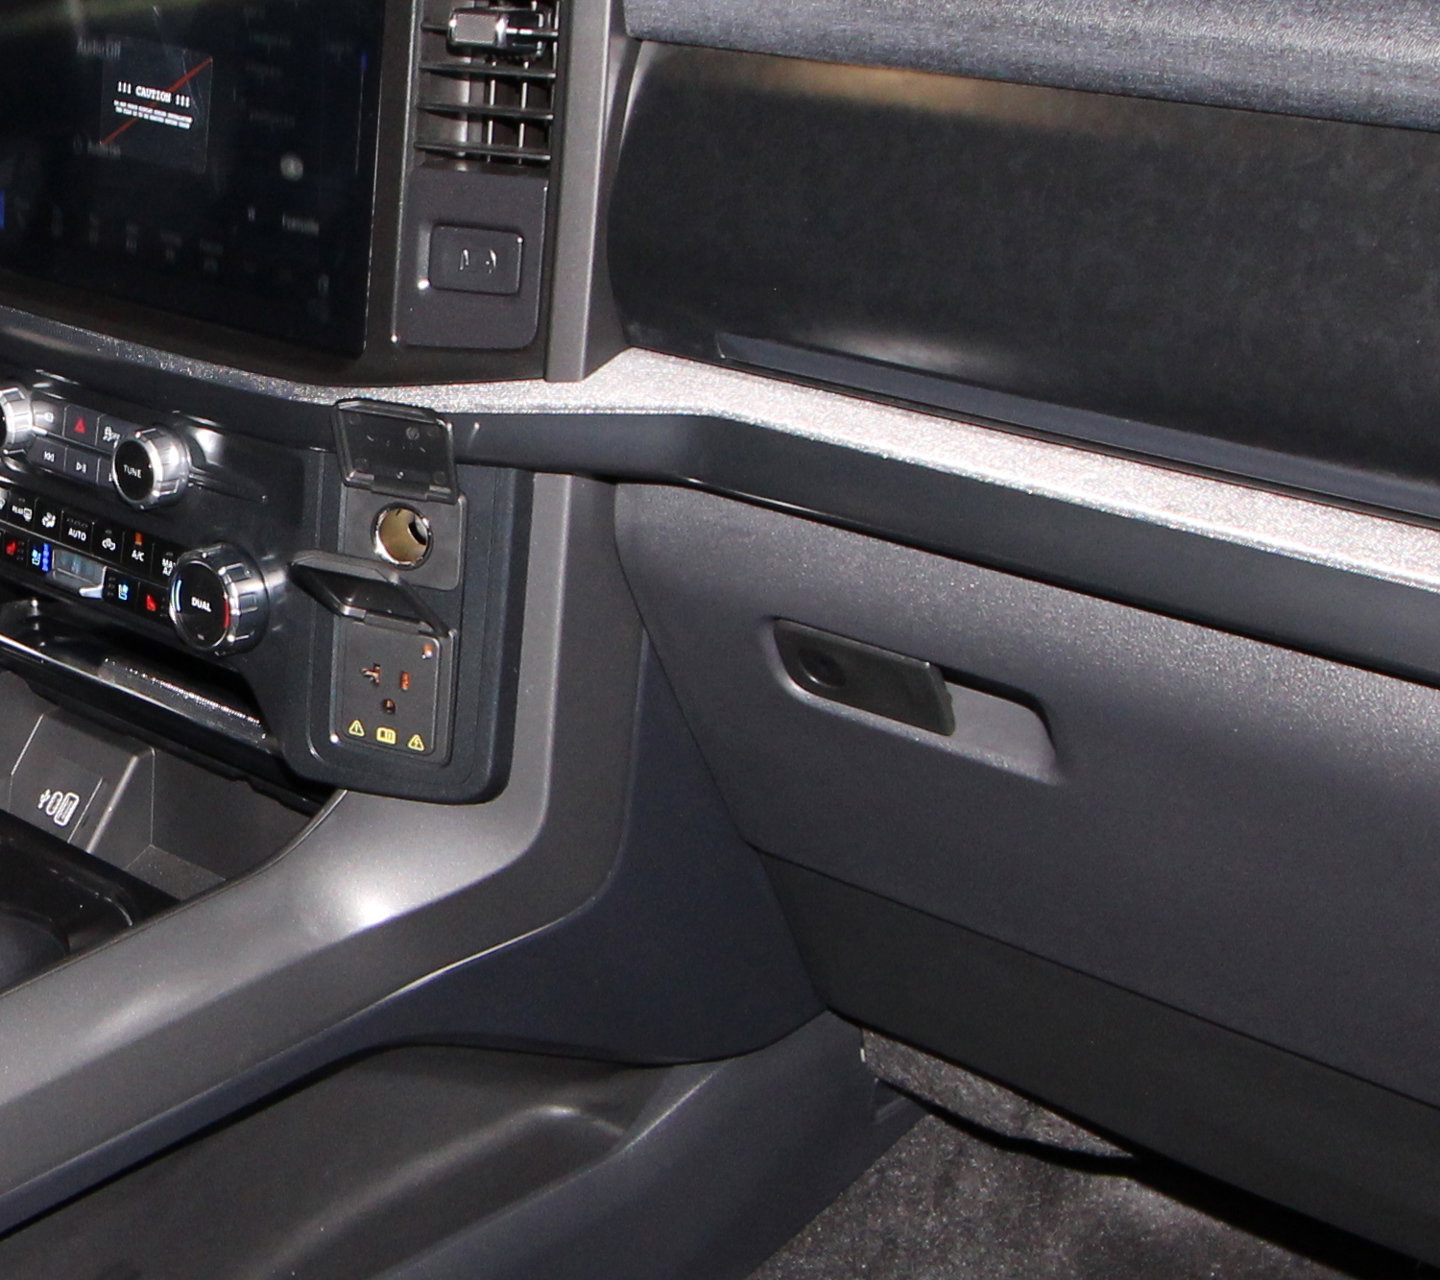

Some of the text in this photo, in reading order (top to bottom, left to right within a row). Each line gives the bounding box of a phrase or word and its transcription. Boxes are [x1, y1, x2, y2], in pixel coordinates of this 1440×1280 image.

[135, 85, 172, 103] CAUTION
[123, 464, 142, 479] TUNE
[67, 527, 87, 542] AUTO
[131, 549, 145, 562] A/C
[191, 596, 212, 613] DUAL
